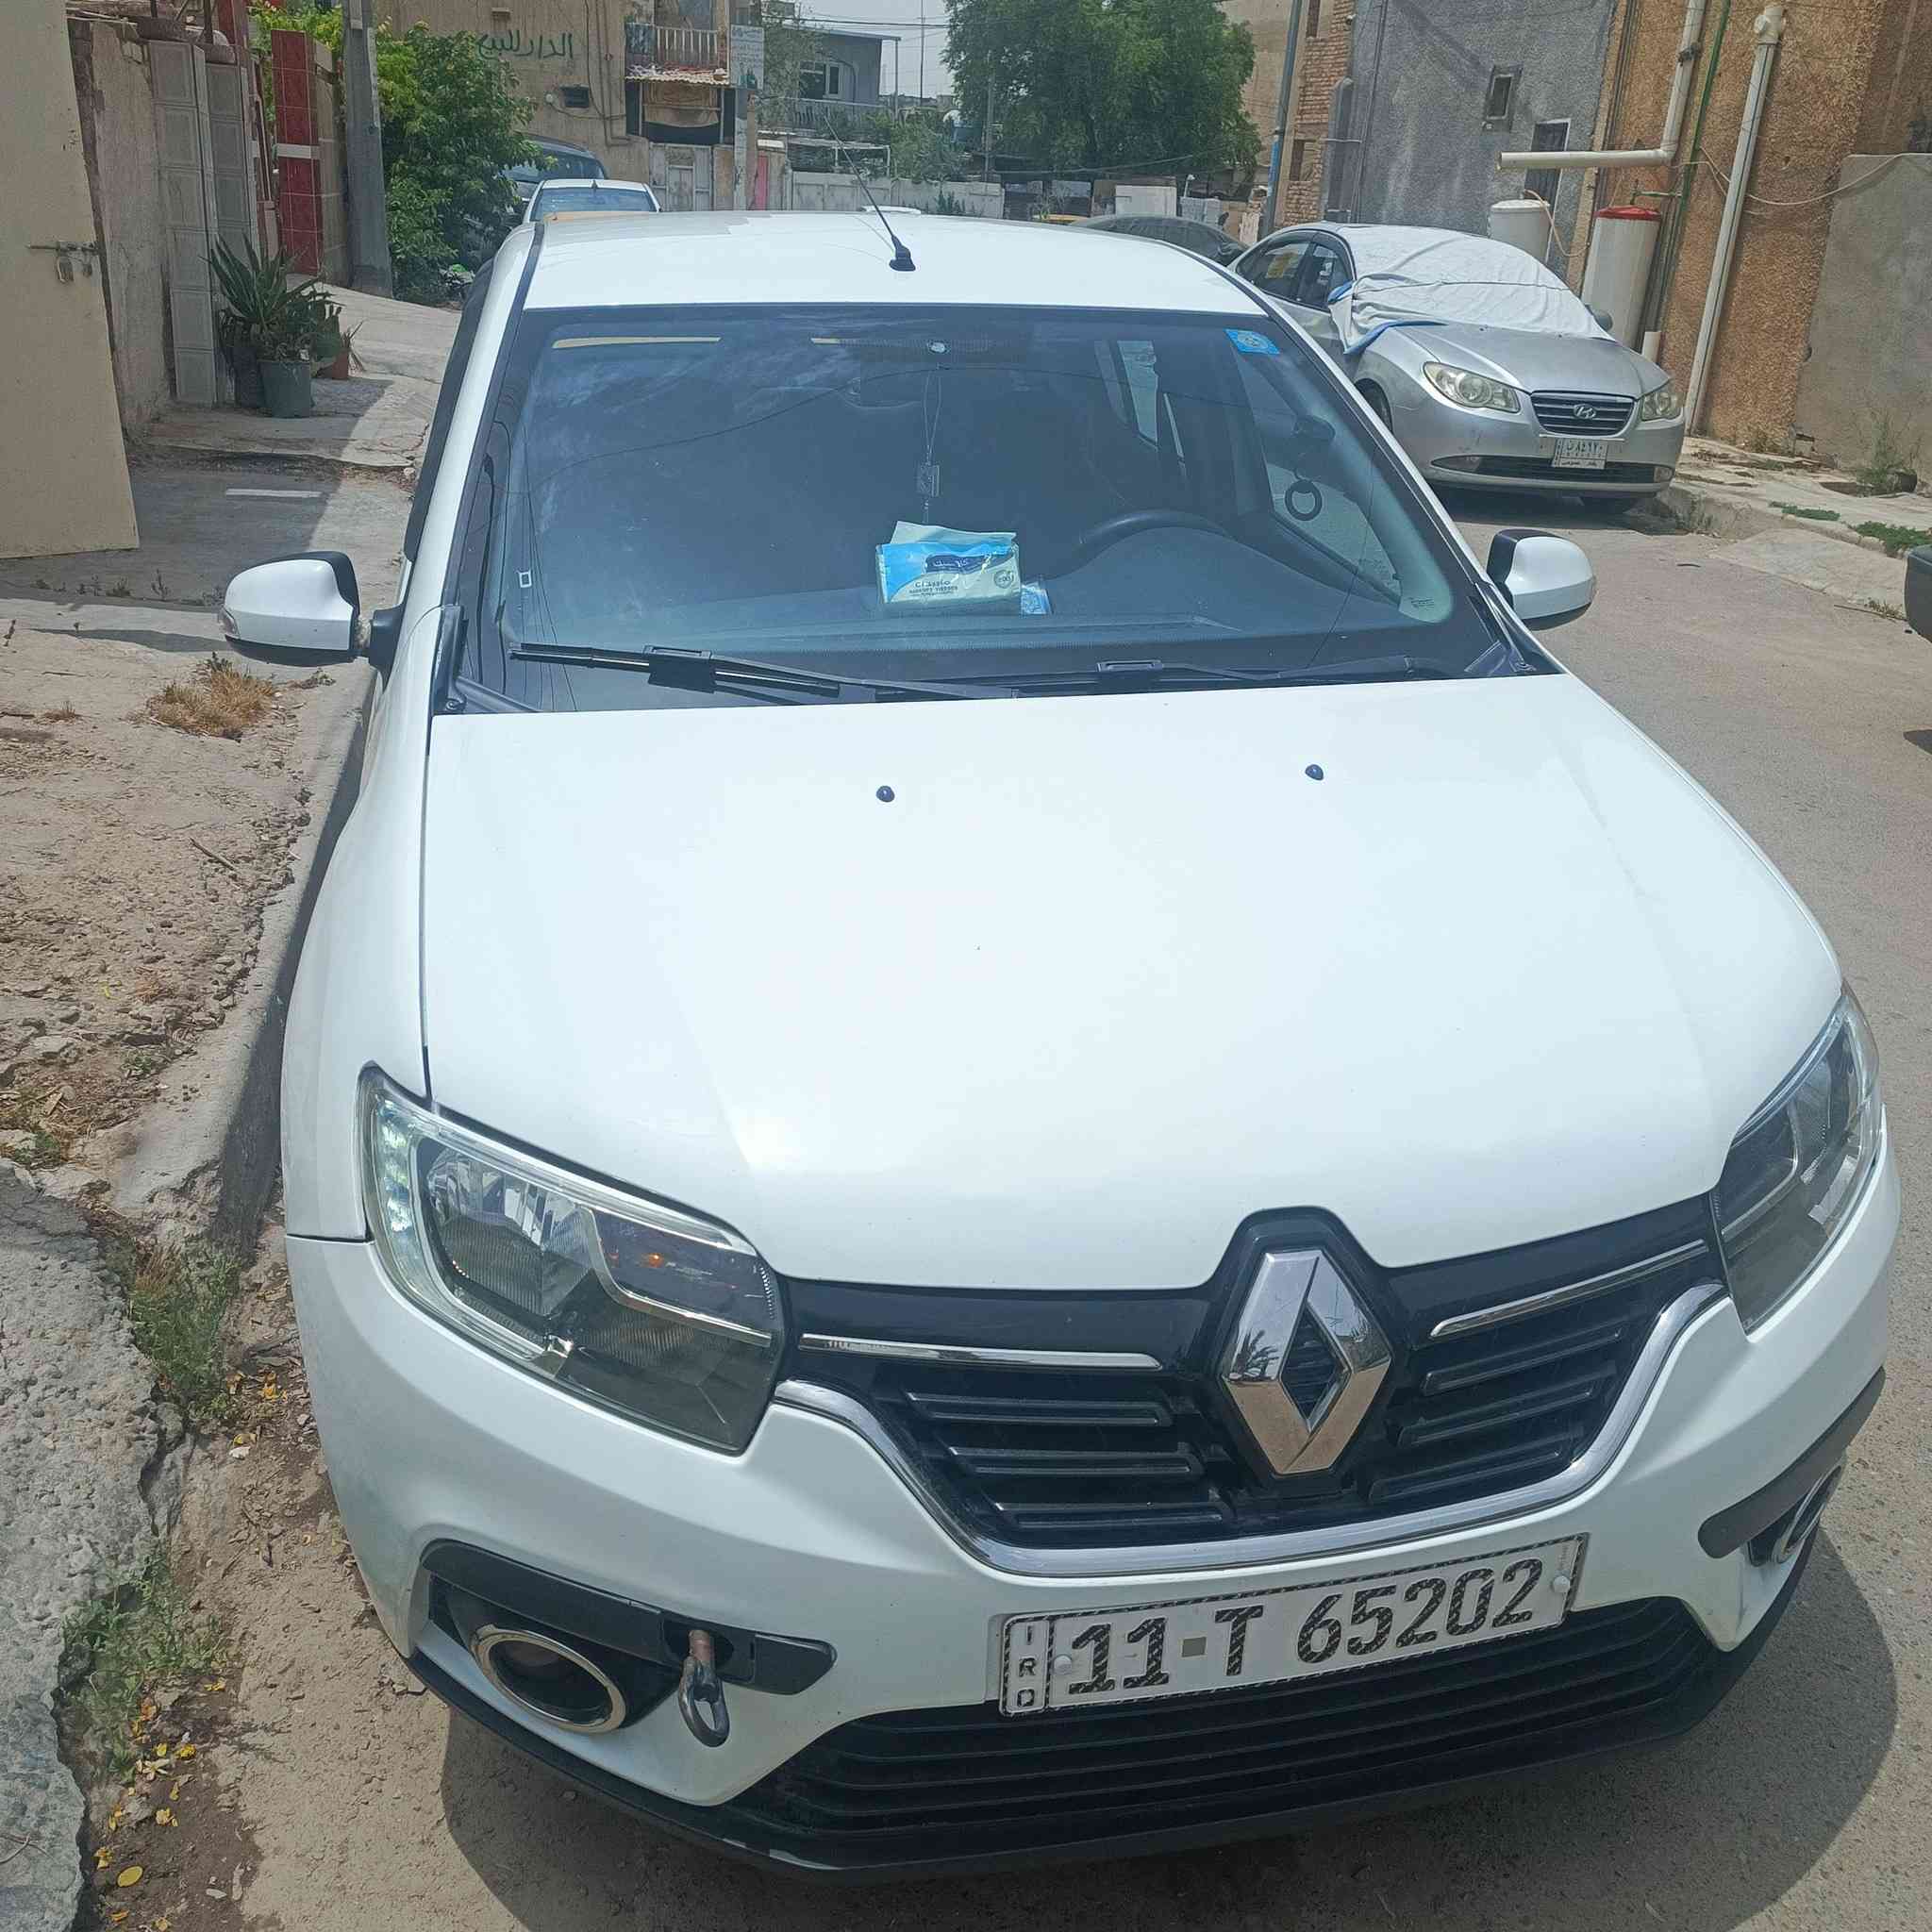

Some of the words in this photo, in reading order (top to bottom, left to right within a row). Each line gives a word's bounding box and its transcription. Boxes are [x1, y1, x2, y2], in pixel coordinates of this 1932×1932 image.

[514, 33, 574, 58] الدار
[1069, 1616, 1170, 1695] 11
[1214, 1605, 1264, 1676] T
[1296, 1558, 1543, 1665] 65202
